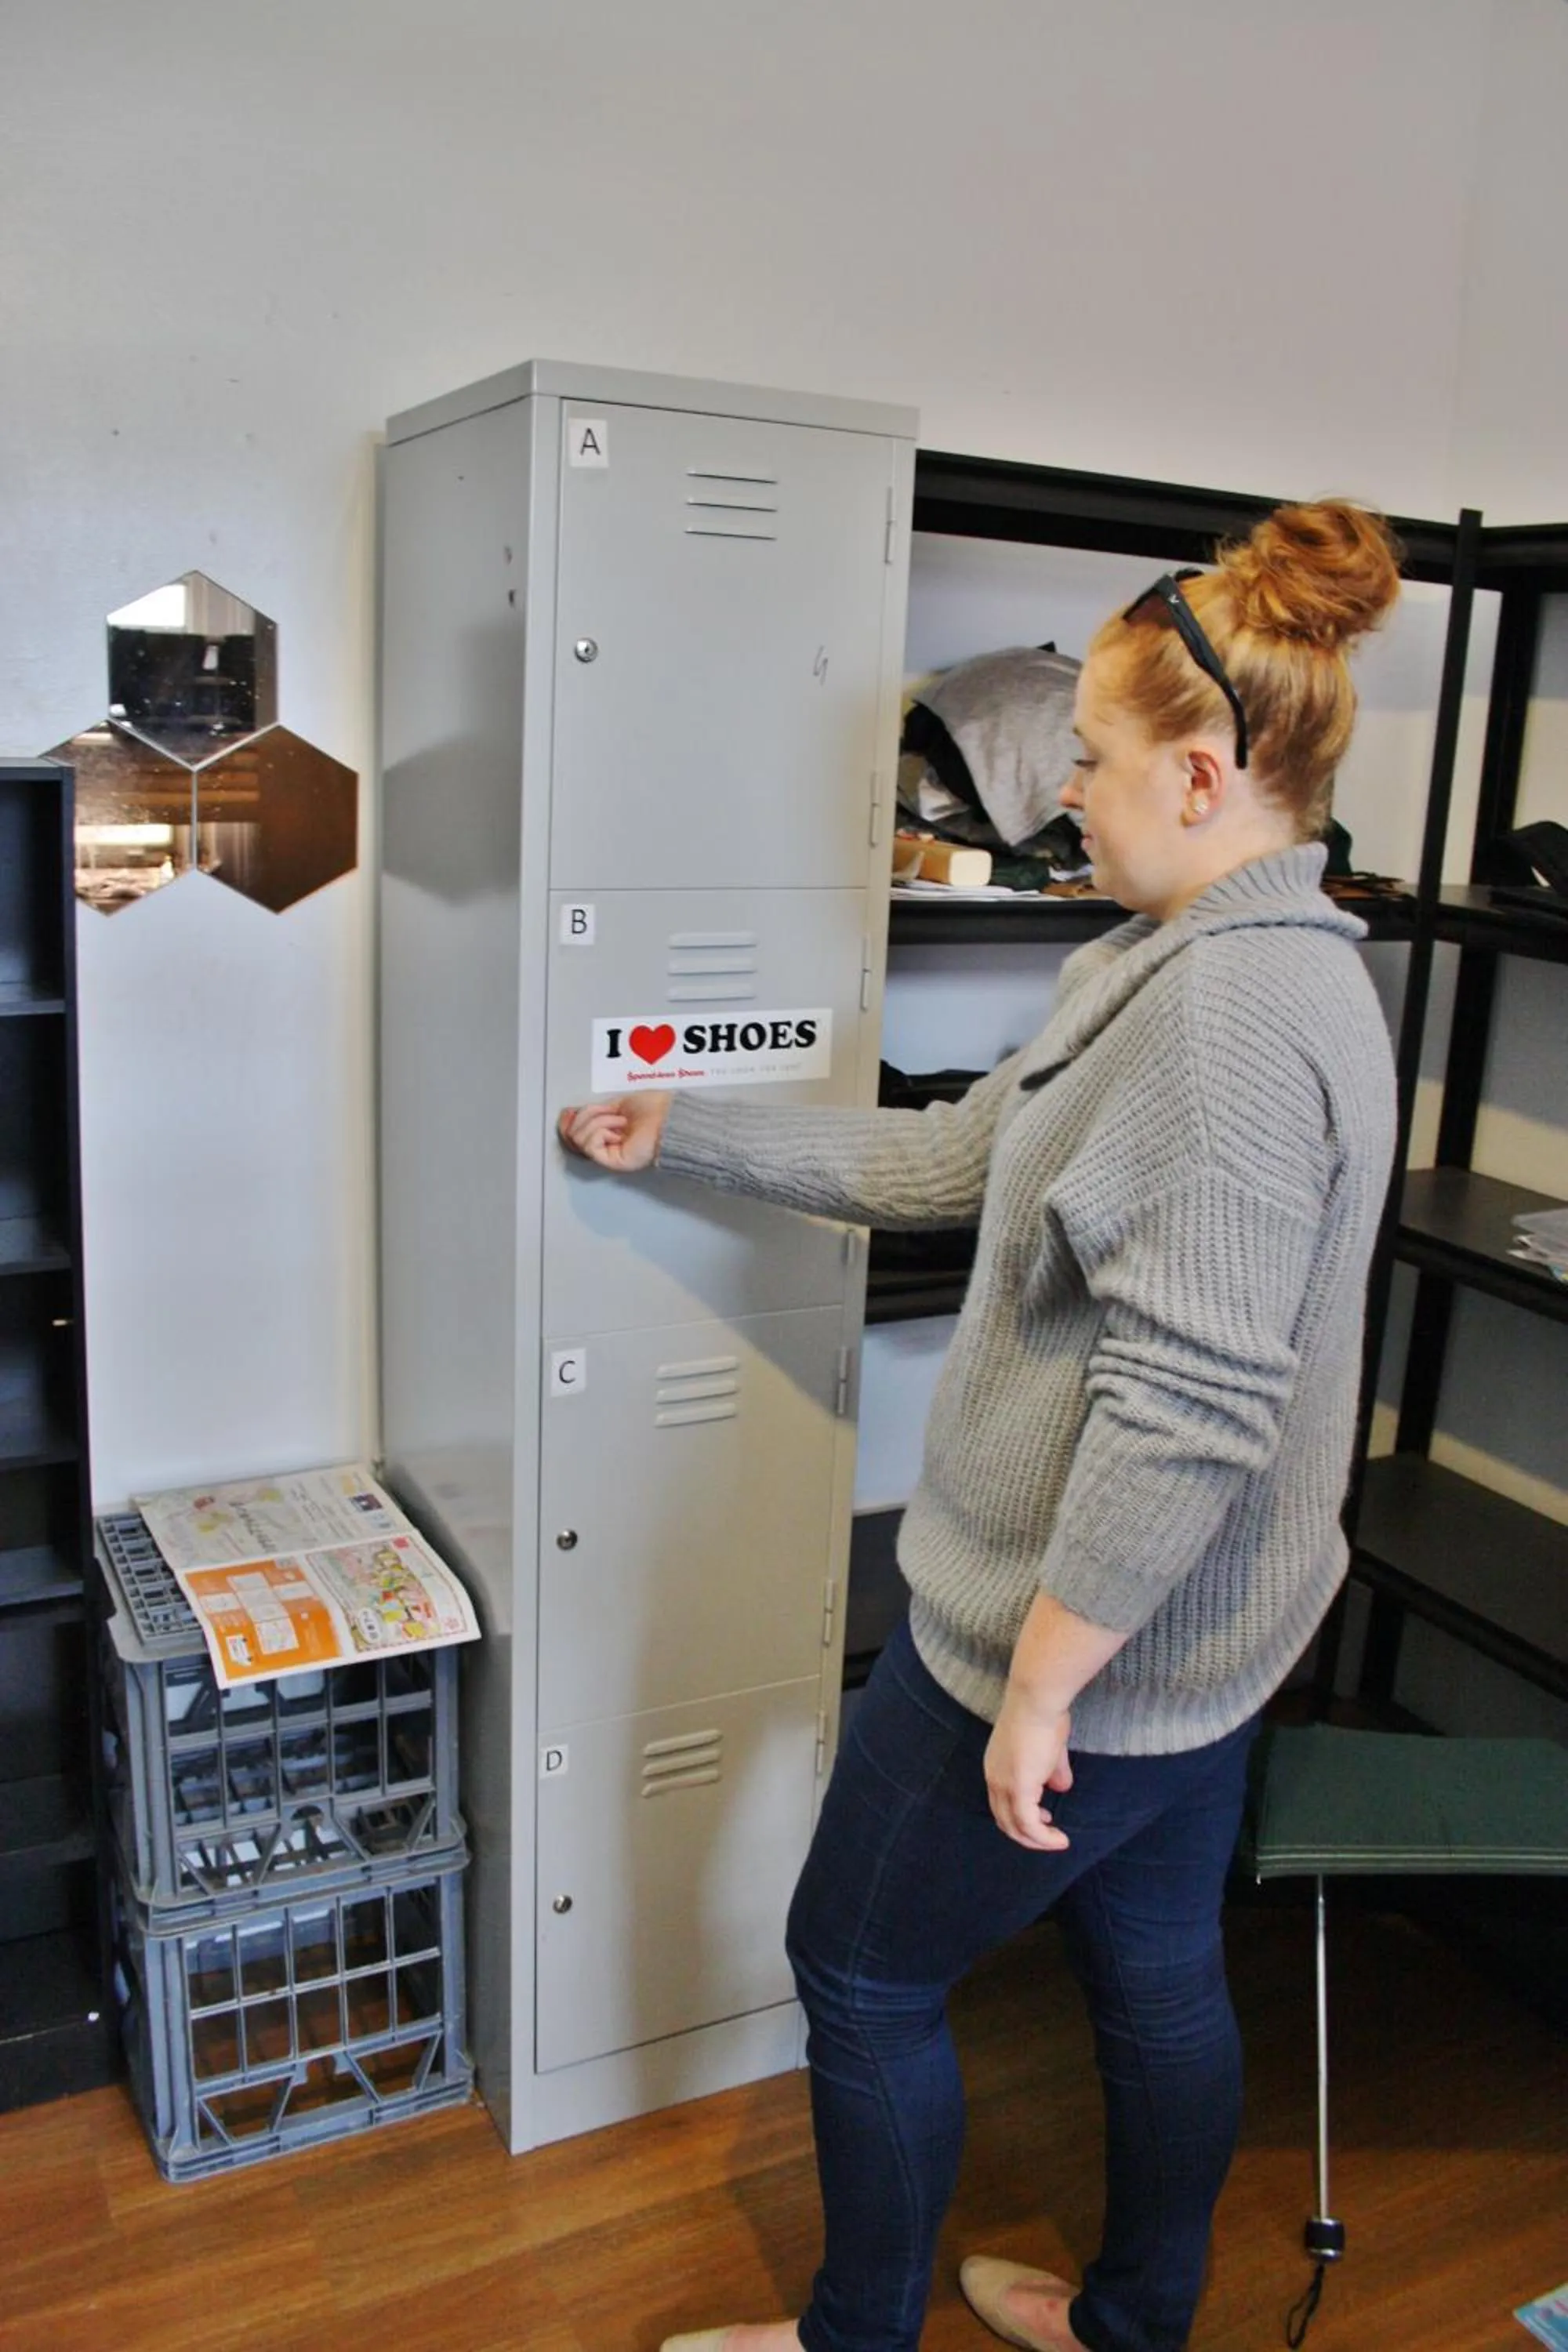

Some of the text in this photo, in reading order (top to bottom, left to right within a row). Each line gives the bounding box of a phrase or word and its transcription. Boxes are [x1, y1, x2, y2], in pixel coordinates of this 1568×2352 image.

[579, 426, 601, 456] A
[571, 908, 588, 935] B
[606, 1019, 818, 1058] I SHOES
[558, 1359, 576, 1384] C
[546, 1749, 563, 1771] D
